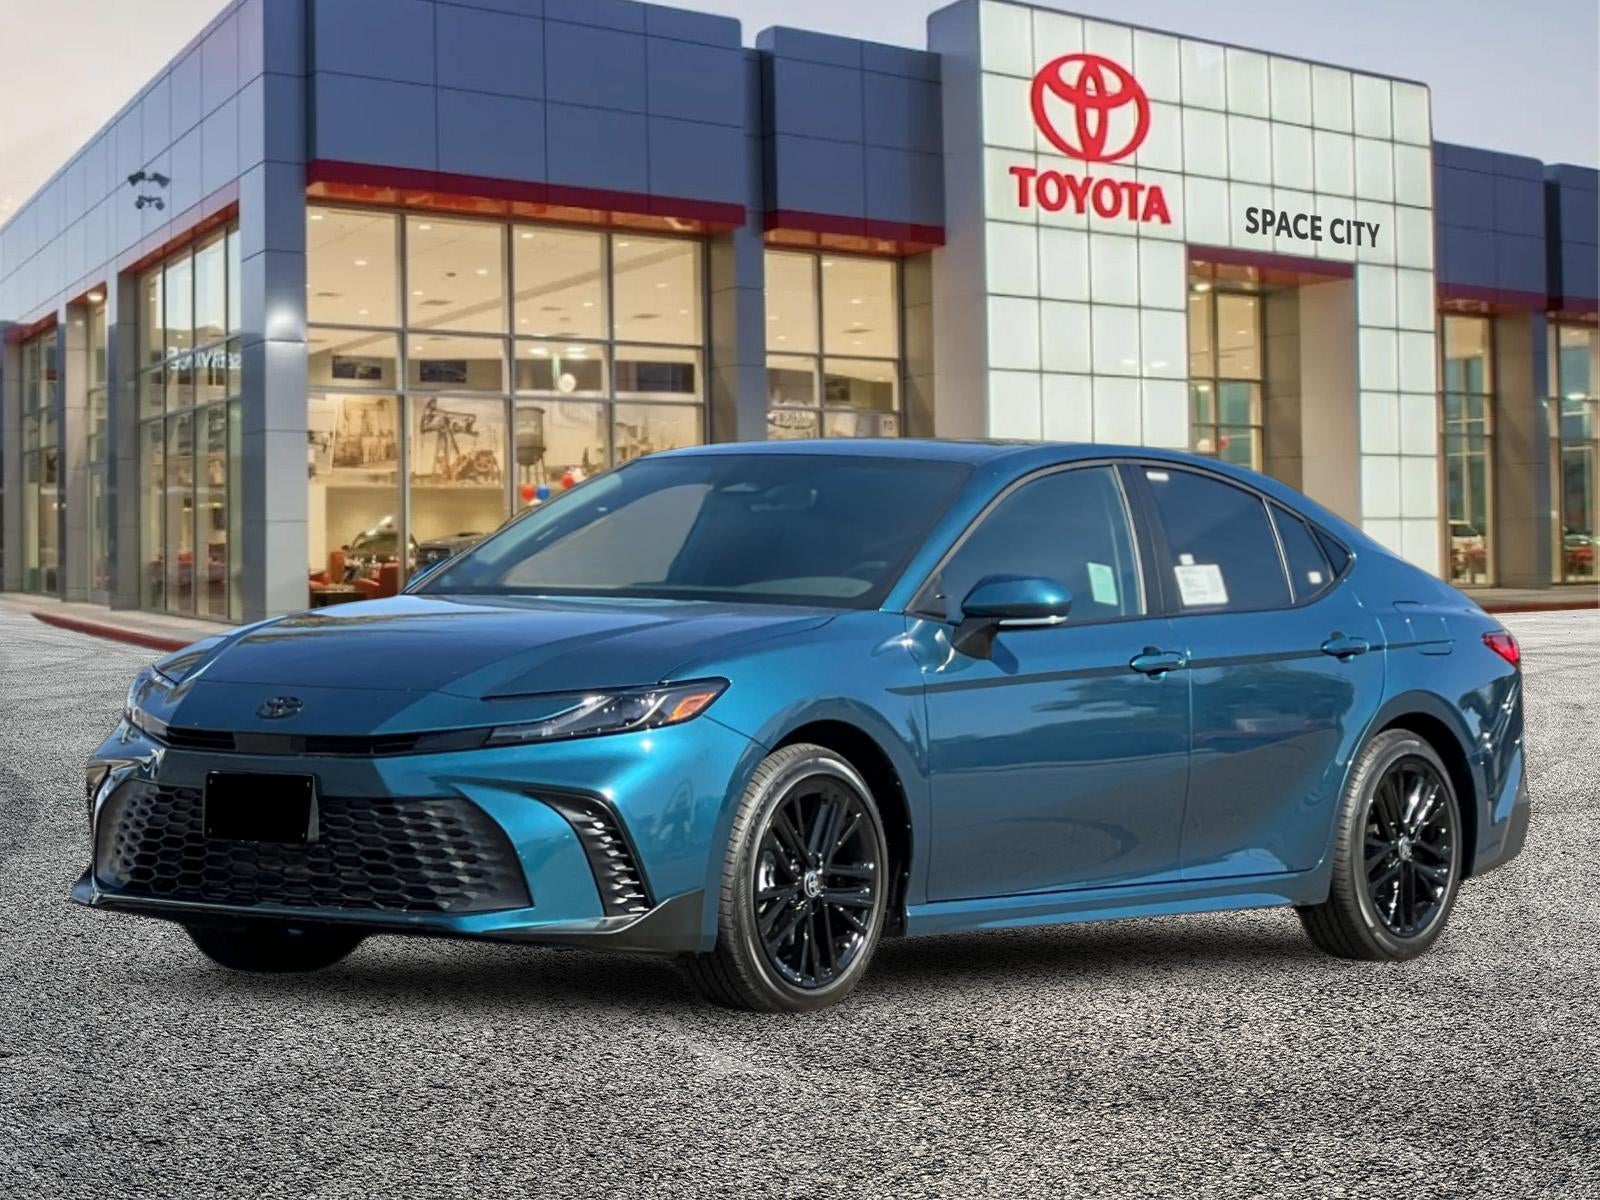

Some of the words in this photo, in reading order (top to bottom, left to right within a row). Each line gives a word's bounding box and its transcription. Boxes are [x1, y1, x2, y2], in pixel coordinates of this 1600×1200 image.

[1009, 166, 1171, 224] TOYOTA
[1245, 206, 1323, 243] SPACE
[1329, 217, 1382, 247] CITY
